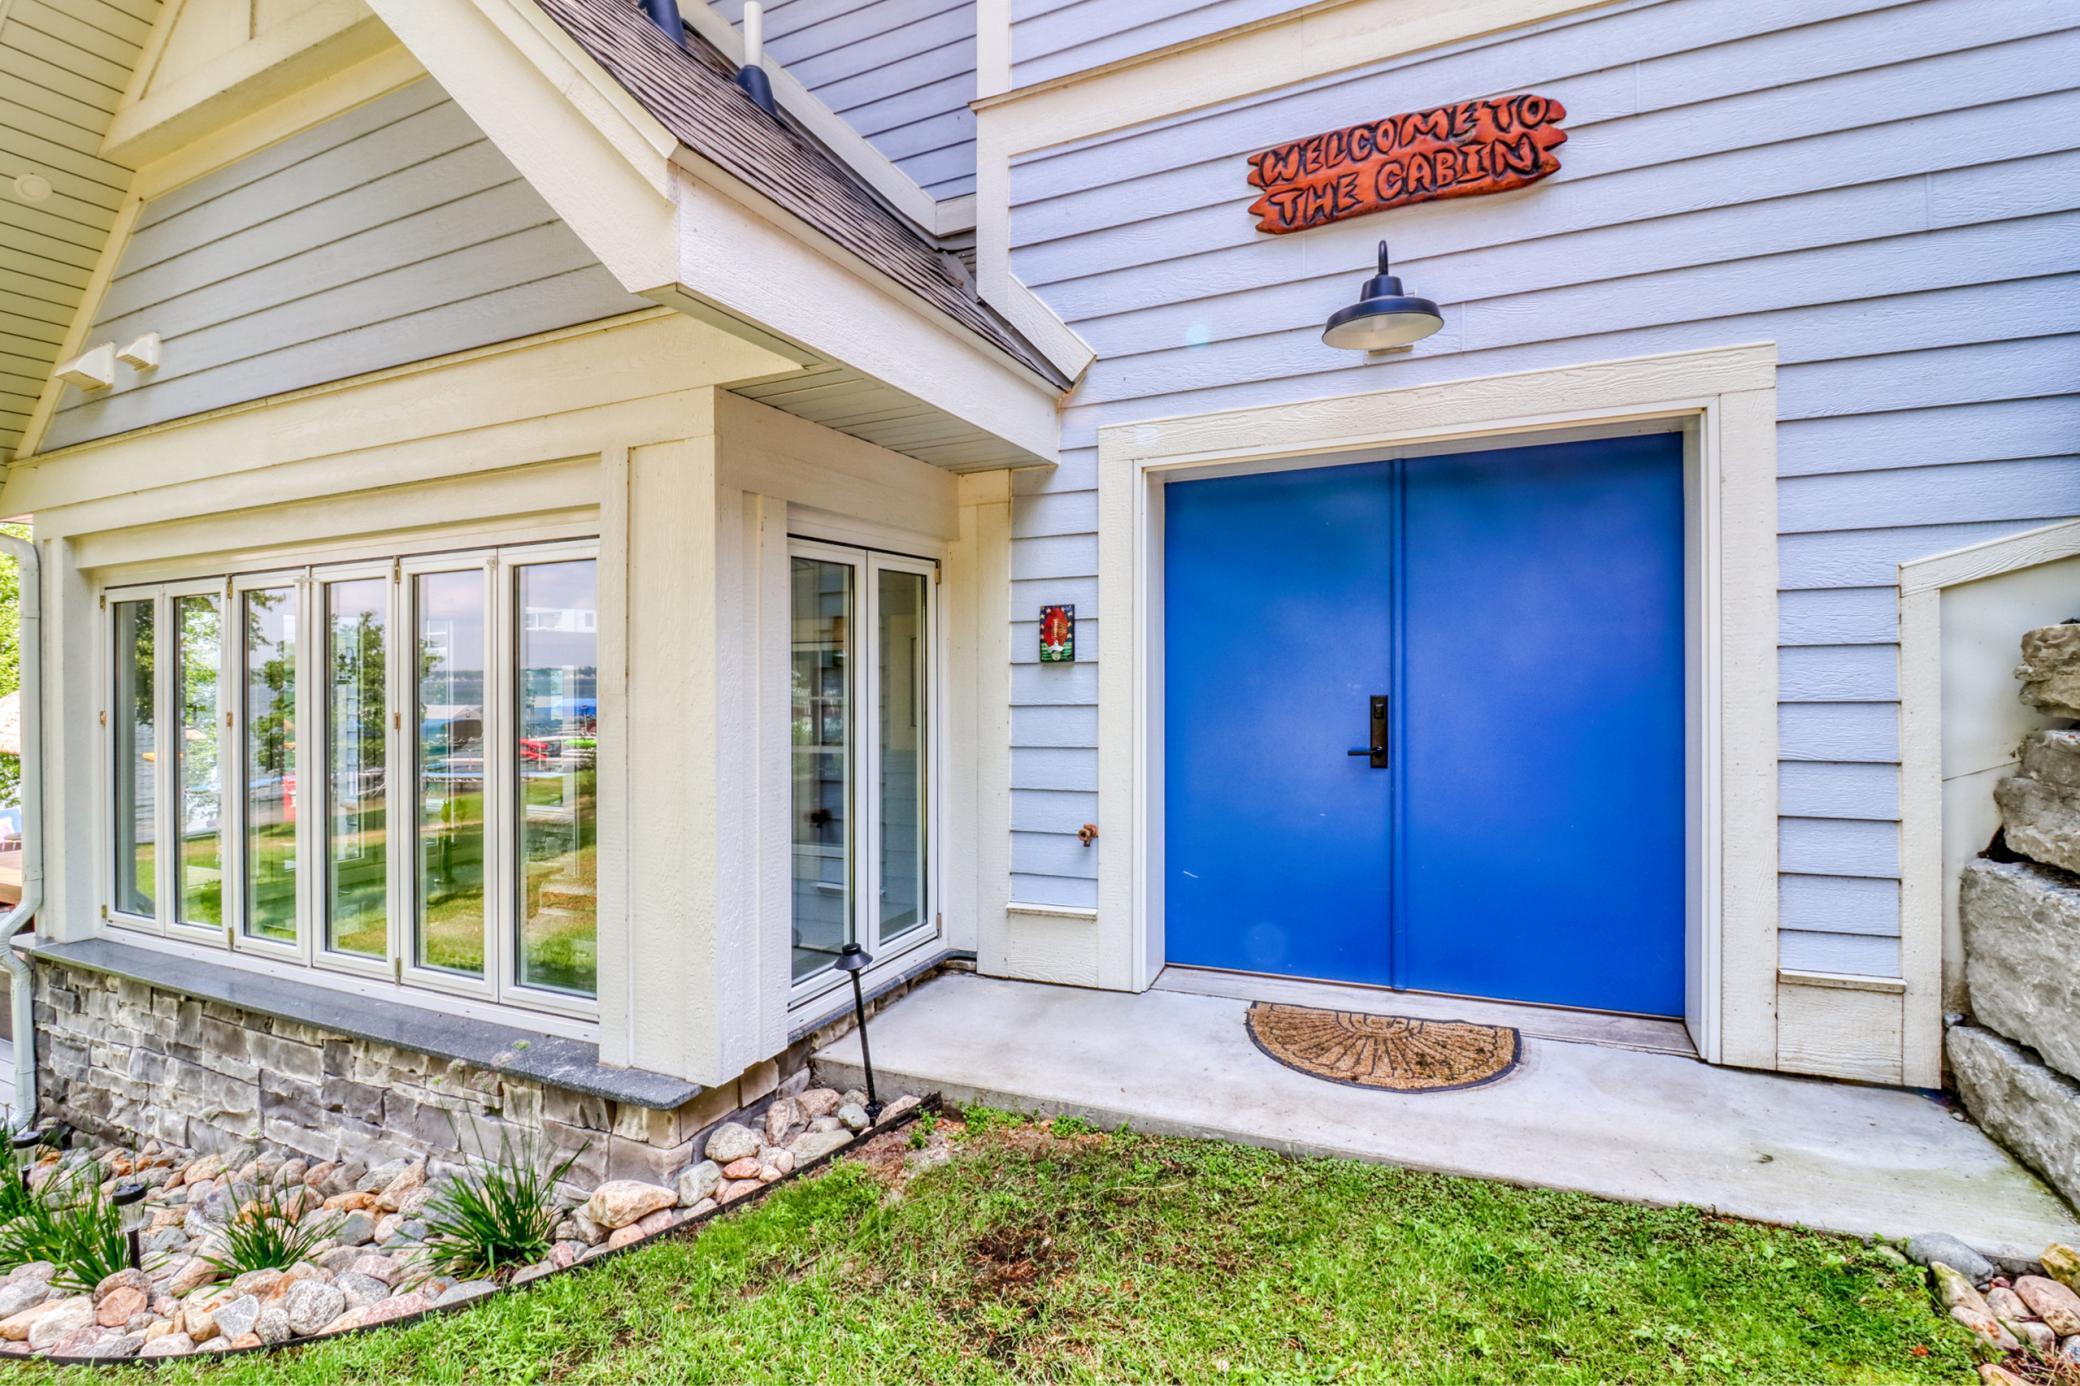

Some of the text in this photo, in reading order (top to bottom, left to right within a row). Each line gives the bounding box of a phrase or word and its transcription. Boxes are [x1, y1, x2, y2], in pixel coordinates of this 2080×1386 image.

[1258, 94, 1550, 187] WELCOME TO
[1268, 132, 1541, 226] THE CABIN
